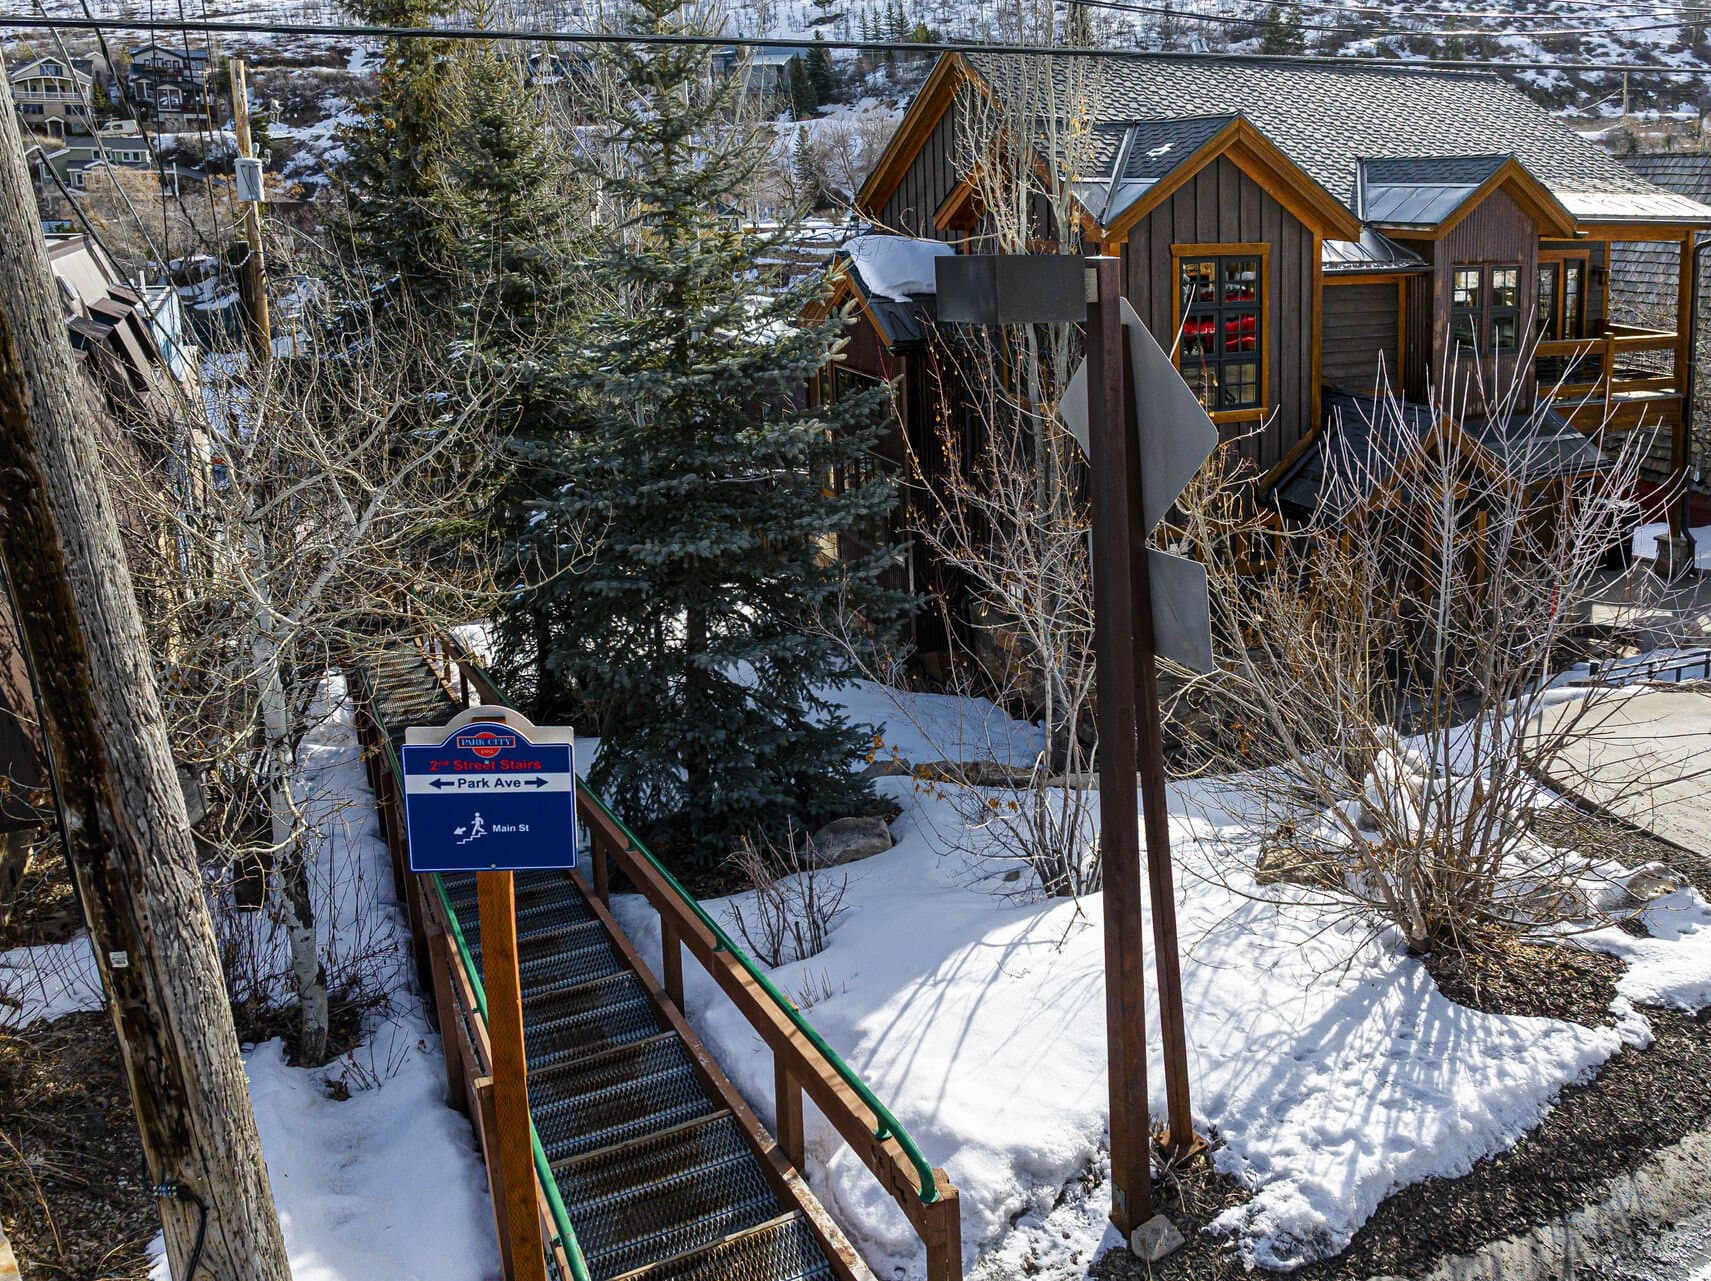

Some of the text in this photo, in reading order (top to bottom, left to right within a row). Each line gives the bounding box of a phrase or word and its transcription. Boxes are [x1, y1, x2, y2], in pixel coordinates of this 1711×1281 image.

[461, 737, 512, 746] PARK CITY
[453, 759, 496, 771] Street
[500, 759, 542, 770] Stairs
[457, 777, 522, 789] Park Ave
[492, 824, 530, 833] Main St
